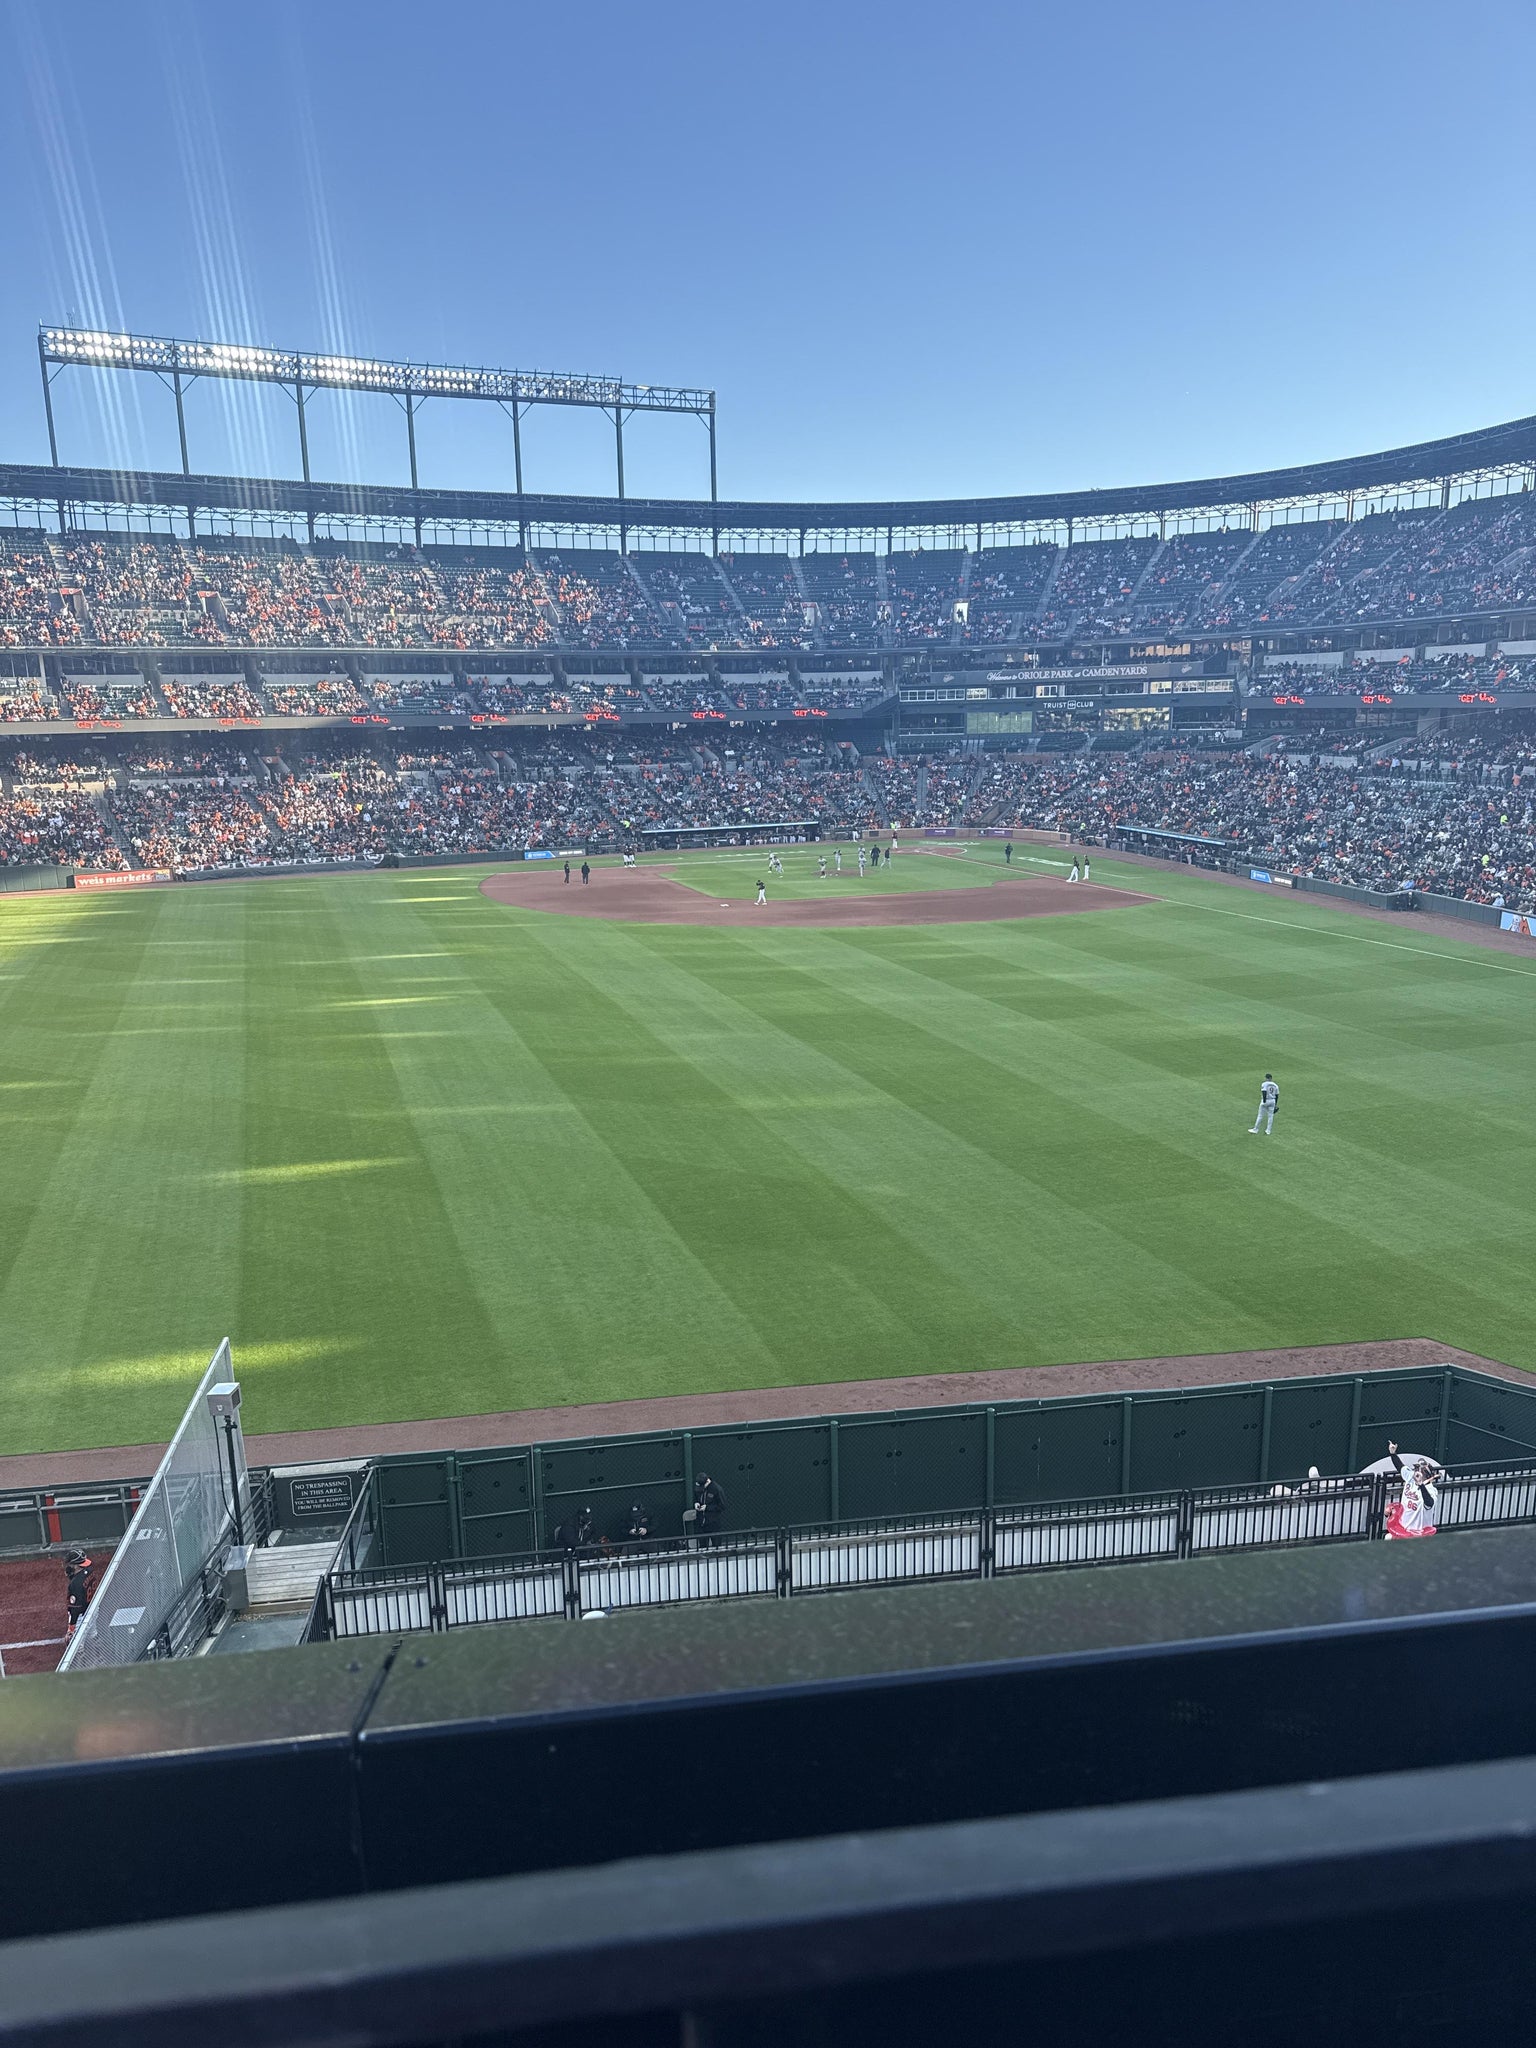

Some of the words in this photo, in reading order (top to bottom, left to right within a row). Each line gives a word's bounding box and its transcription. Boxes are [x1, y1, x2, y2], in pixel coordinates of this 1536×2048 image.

[1018, 670, 1050, 680] ORIOLE
[1050, 669, 1073, 679] PARK
[1082, 667, 1120, 677] CAMDEN
[1120, 666, 1148, 676] YARDS
[79, 876, 104, 886] weis
[105, 873, 152, 884] markets
[305, 1480, 348, 1490] TRESPASSING
